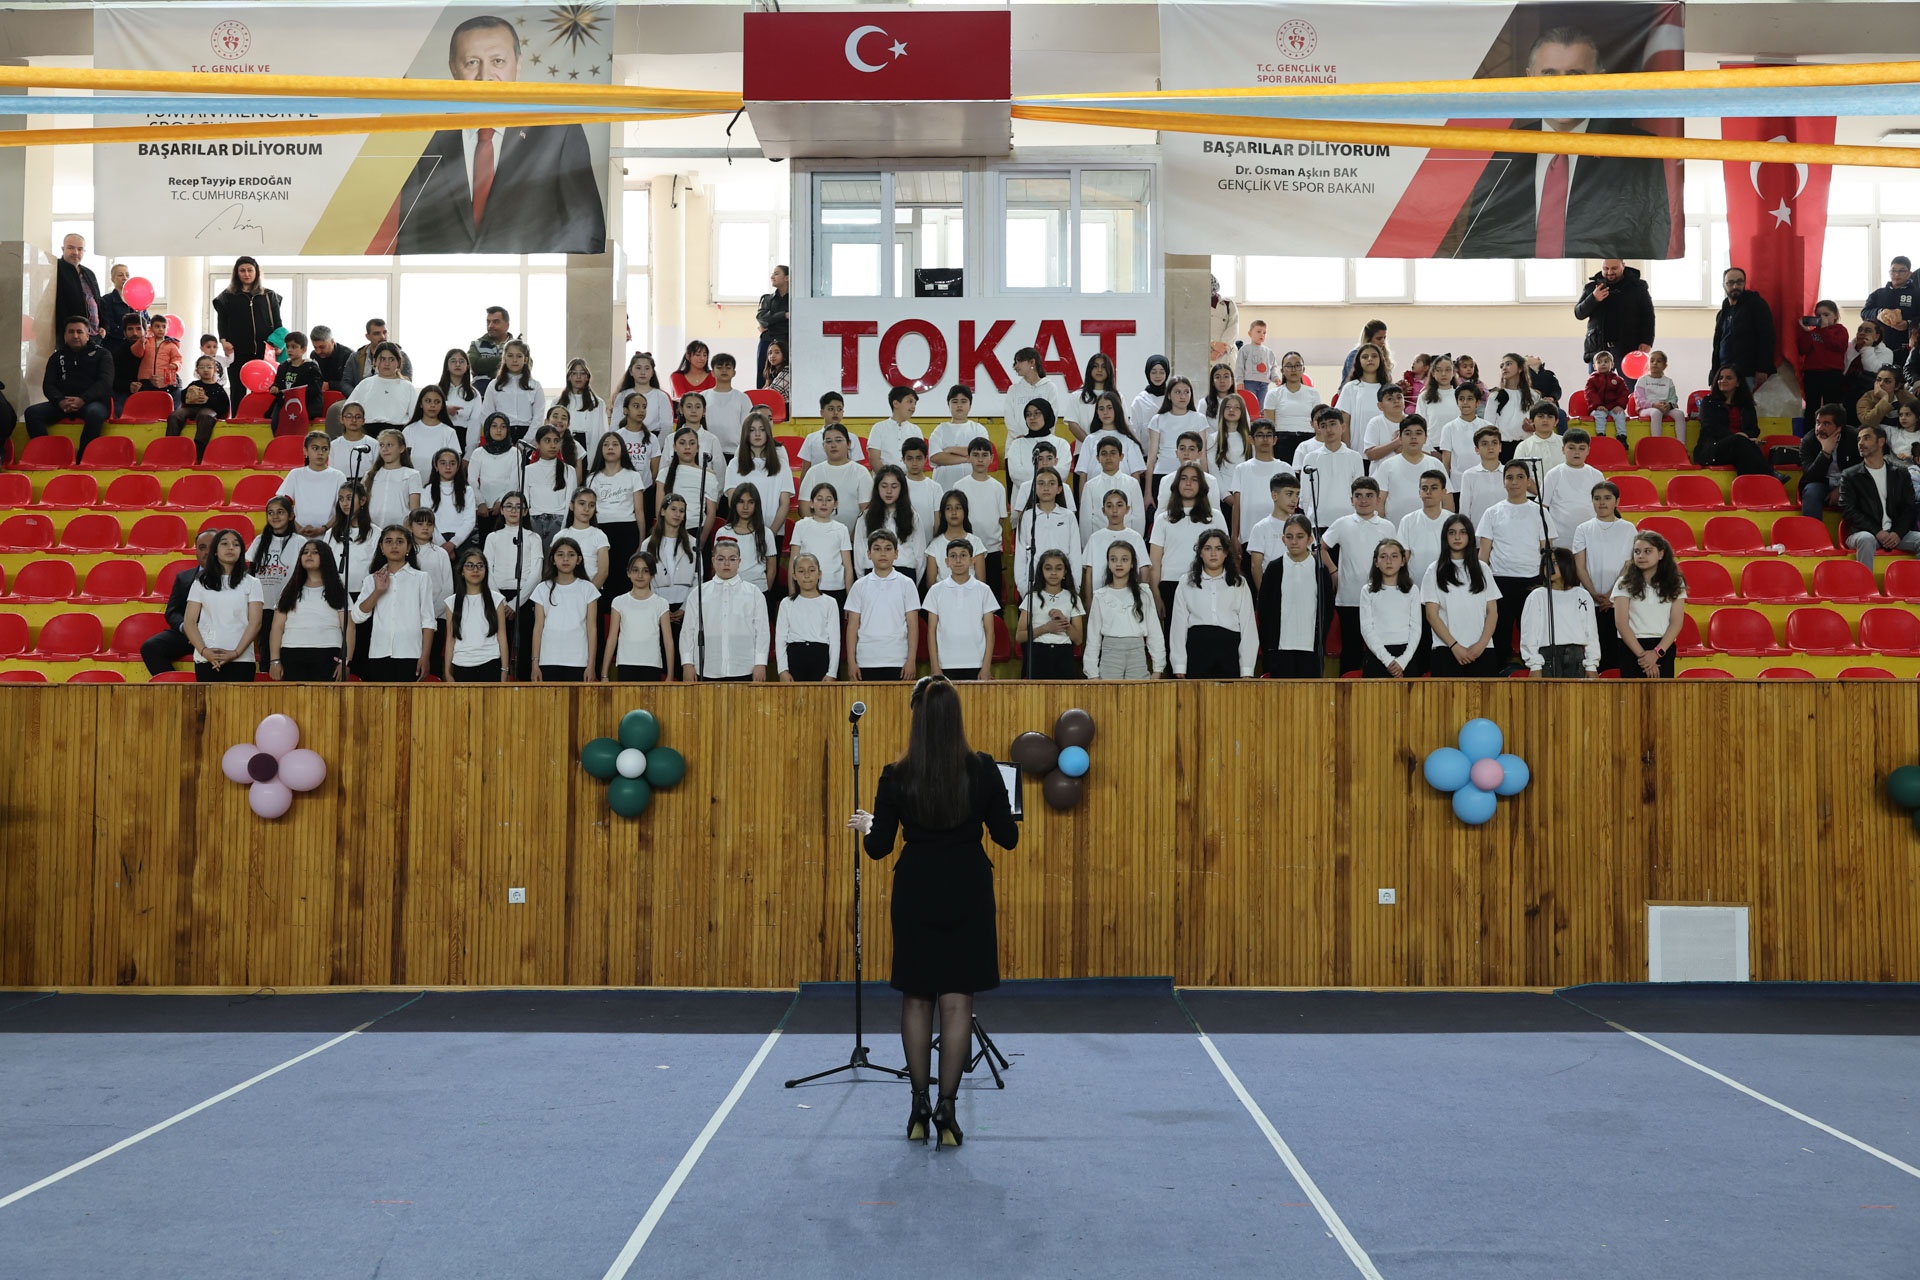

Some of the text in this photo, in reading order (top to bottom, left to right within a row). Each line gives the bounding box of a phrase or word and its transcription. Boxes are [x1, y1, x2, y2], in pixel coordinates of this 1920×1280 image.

[192, 64, 270, 74] T.C. GENÇLİK VE
[1257, 63, 1337, 74] T.C. GENÇLİK VE
[1257, 74, 1337, 84] SPOR BAKANLIĞI
[138, 140, 323, 159] BAŞARILAR DİLİYORUM
[1203, 140, 1391, 157] BAŞARILAR DİLİYORUM
[1235, 165, 1358, 179] Dr. Osman Aşkın BAK
[168, 174, 292, 188] Recep Tayyip ERDOĞAN
[1218, 178, 1375, 194] GENÇLİK VE SPOR BAKANI
[171, 190, 289, 202] T.C. CUMHURBAŞKANI
[1900, 295, 1912, 303] 92
[822, 318, 1137, 395] TOKAT
